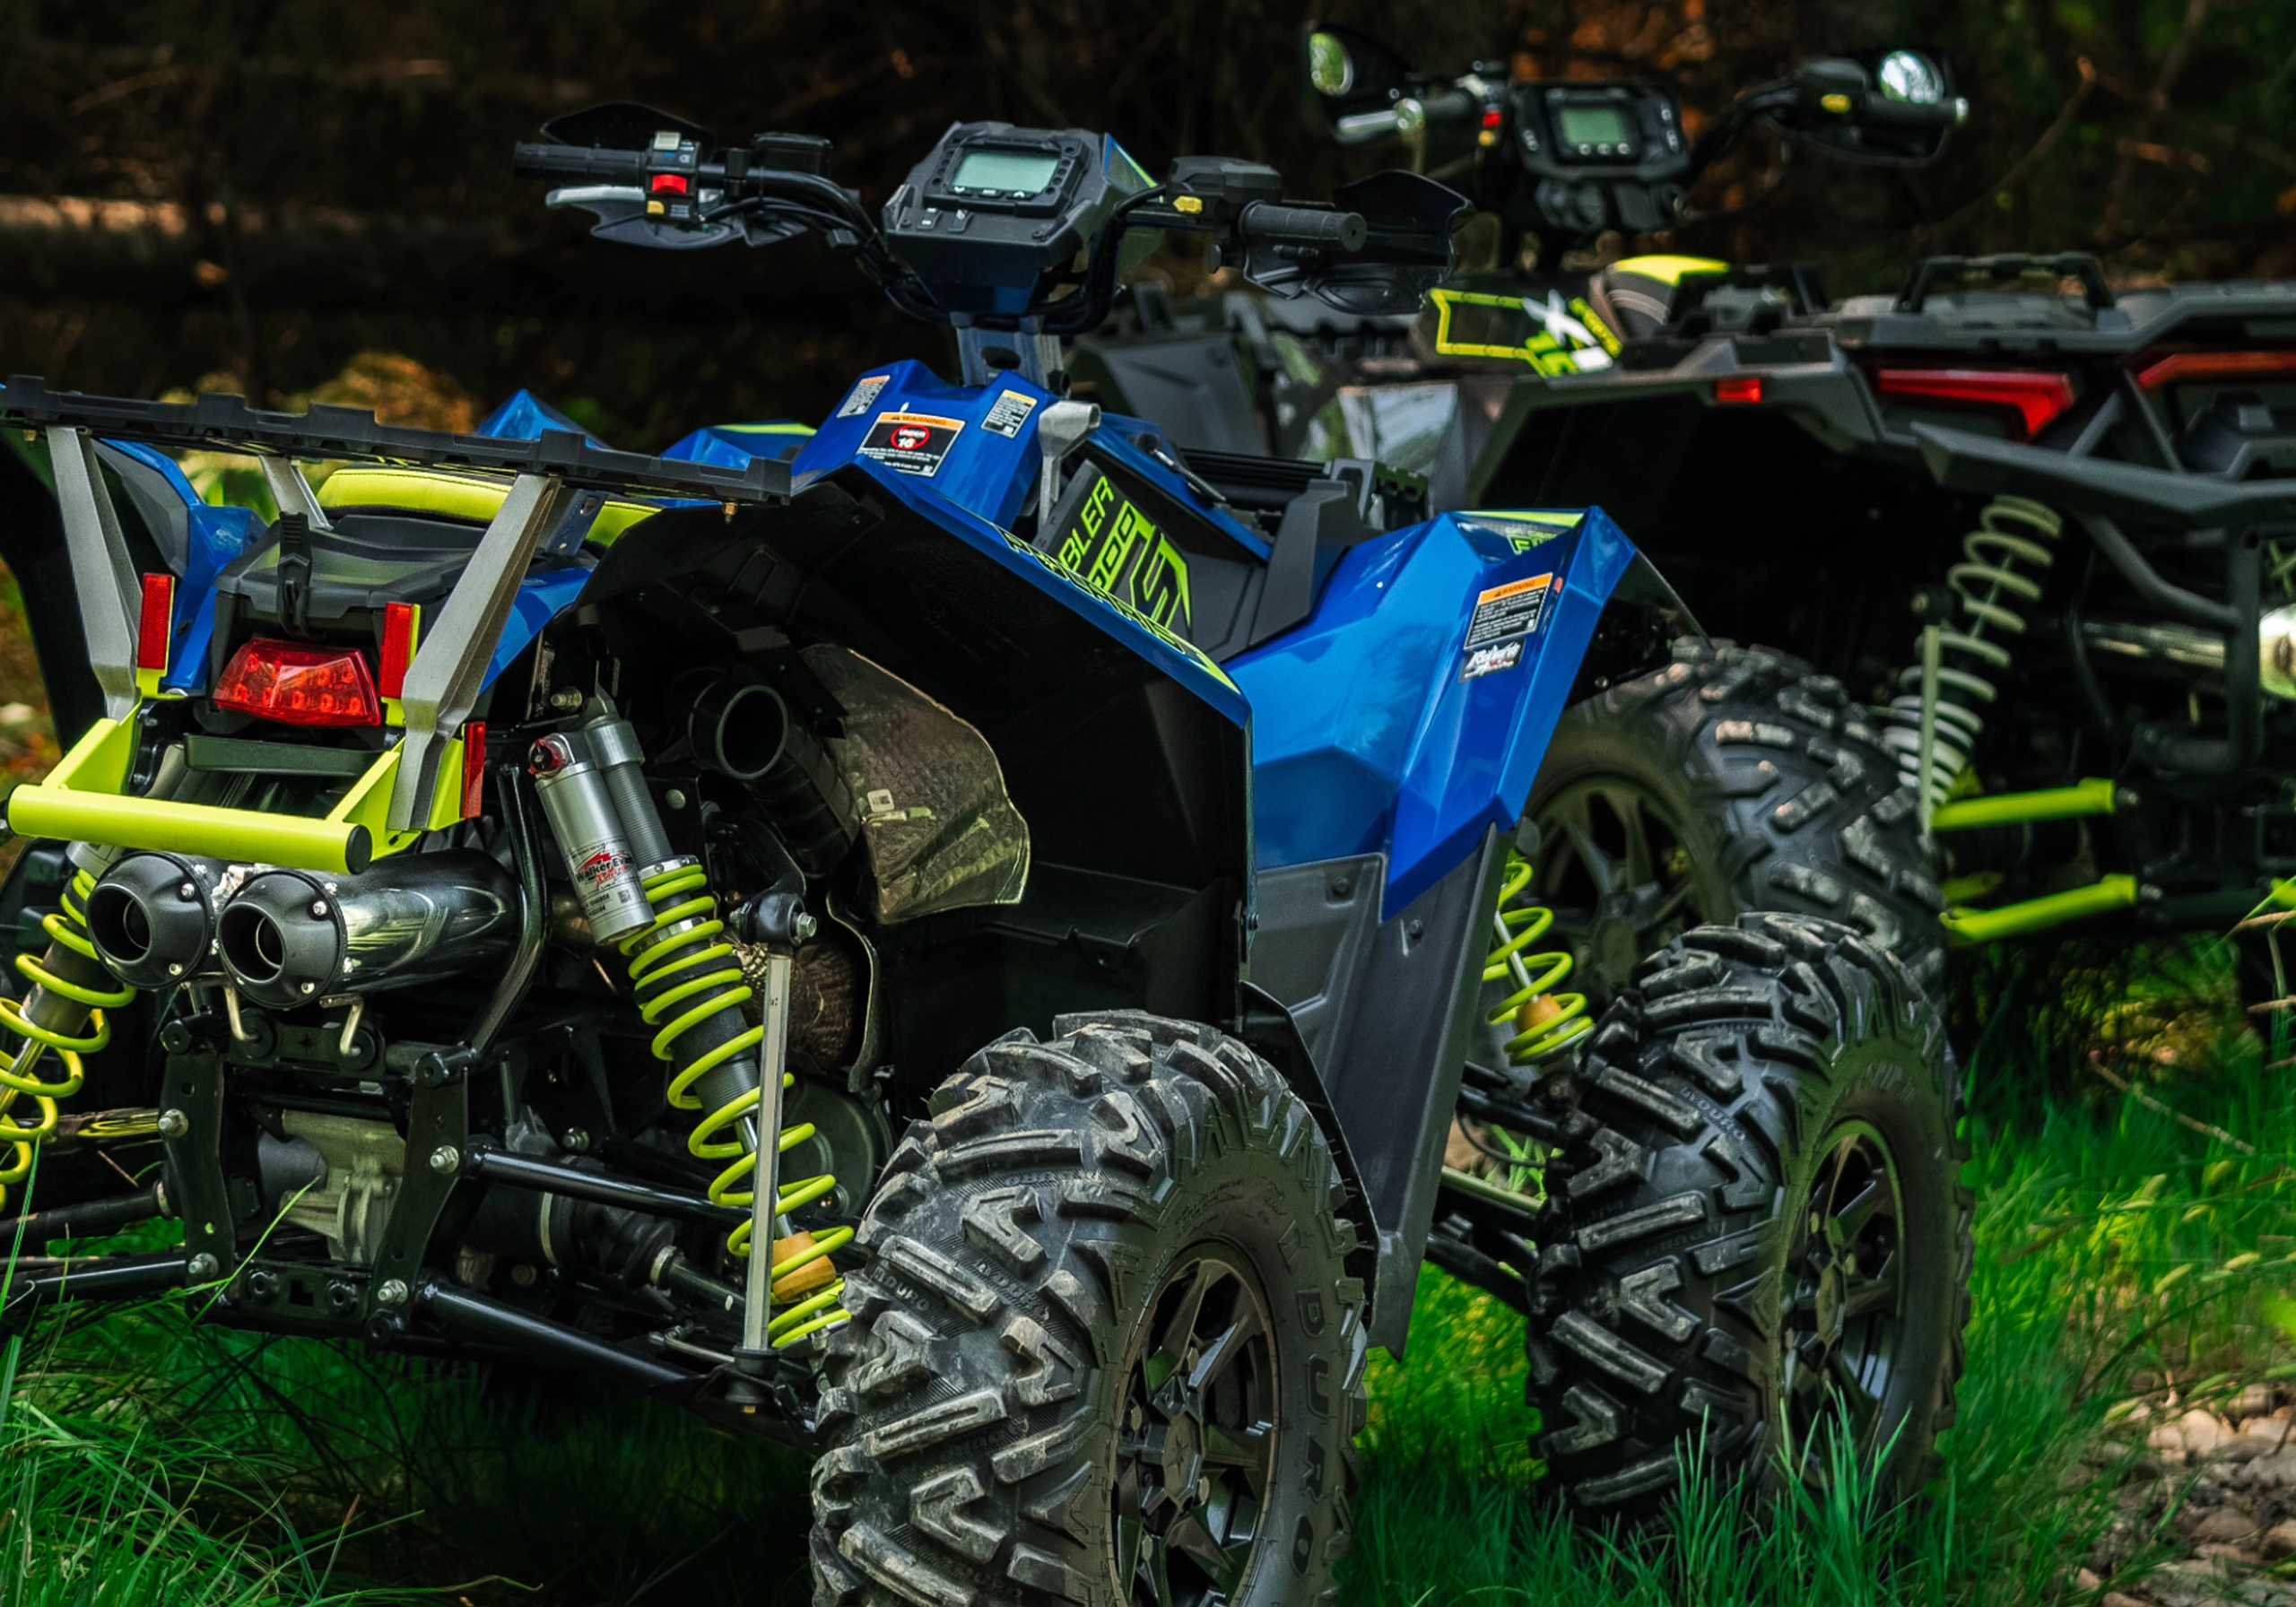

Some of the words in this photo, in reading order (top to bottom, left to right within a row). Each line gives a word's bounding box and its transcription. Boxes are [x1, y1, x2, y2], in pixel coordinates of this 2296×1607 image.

[902, 415, 946, 426] WARNING
[898, 437, 916, 448] 16
[1502, 580, 1535, 593] WARNING
[576, 861, 612, 883] Walker
[1291, 1285, 1329, 1576] DURO
